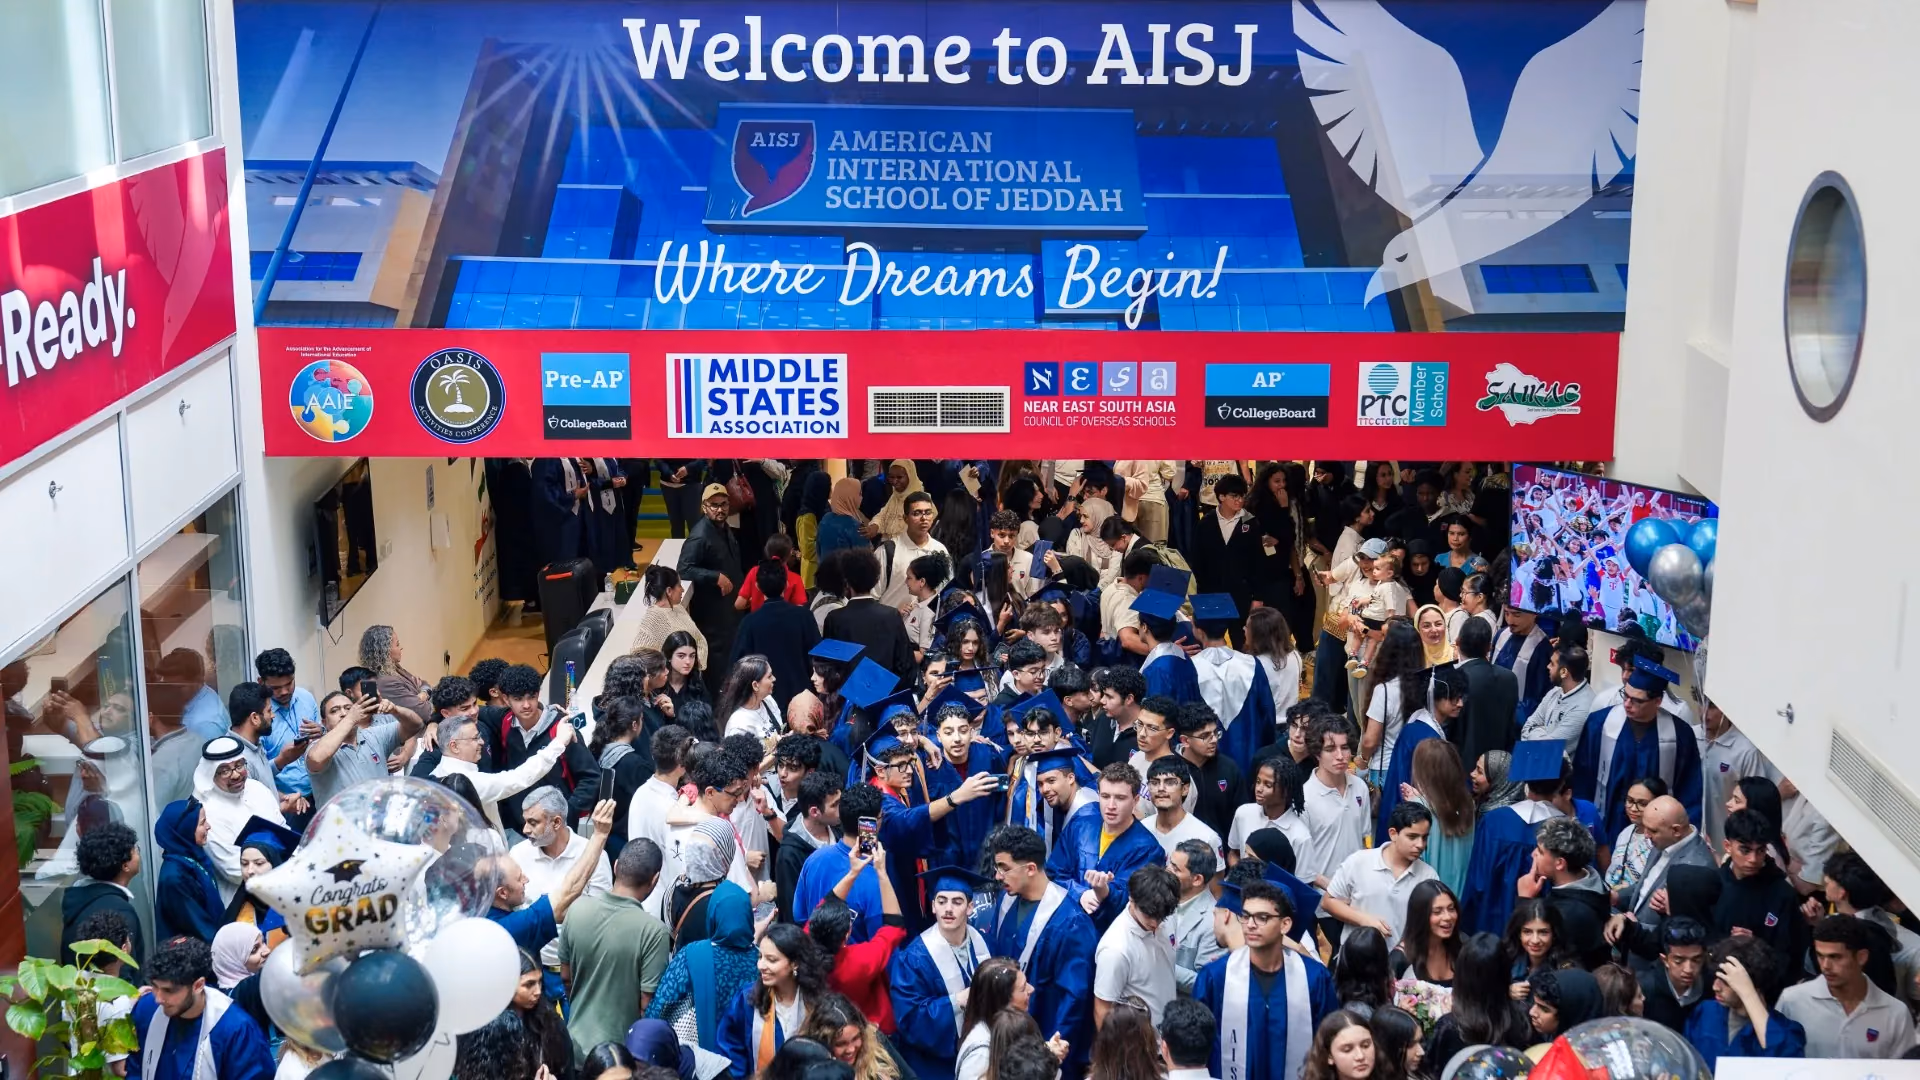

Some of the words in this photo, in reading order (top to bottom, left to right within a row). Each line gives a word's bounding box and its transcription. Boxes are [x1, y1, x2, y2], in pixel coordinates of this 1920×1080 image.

[622, 16, 971, 84] Welcome
[992, 27, 1068, 85] to
[1087, 23, 1258, 86] AISJ
[750, 132, 801, 148] AISJ
[828, 130, 993, 153] AMERICAN
[826, 158, 1081, 183] INTERNATIONAL
[825, 185, 947, 210] SCHOOL
[952, 187, 992, 210] OF
[995, 188, 1124, 212] JEDDAH
[654, 240, 826, 305] Where
[838, 241, 1034, 306] Dreams
[1058, 244, 1228, 330] Begin!
[0, 256, 136, 388] Ready.
[430, 353, 483, 369] OASIS
[708, 359, 839, 383] MIDDLE
[545, 370, 624, 388] Pre-AP
[1252, 372, 1282, 388] AP
[304, 393, 357, 414] AAIE
[708, 387, 840, 416] STATES
[1412, 365, 1427, 422] Member
[1430, 371, 1445, 418] School
[1023, 401, 1058, 413] NEAR
[1062, 401, 1095, 413] EAST
[1099, 401, 1142, 413] SOUTH
[1146, 401, 1176, 413] ASIA
[1232, 407, 1316, 421] CollegeBoard
[1360, 394, 1408, 417] PTC
[419, 405, 453, 437] ACTIVITIES
[455, 405, 498, 437] CONFERENCE
[560, 419, 627, 430] CollegeBoard
[709, 420, 840, 434] ASSOCIATION
[1023, 416, 1063, 427] COUNCIL
[1066, 416, 1079, 427] OF
[1081, 416, 1130, 427] OVERSEAS
[1133, 416, 1176, 427] SCHOOLS
[1359, 418, 1375, 426] TTC
[1375, 418, 1391, 426] CTC
[1392, 418, 1409, 426] BTC
[311, 876, 388, 906] Congrats
[305, 894, 398, 934] GRAD
